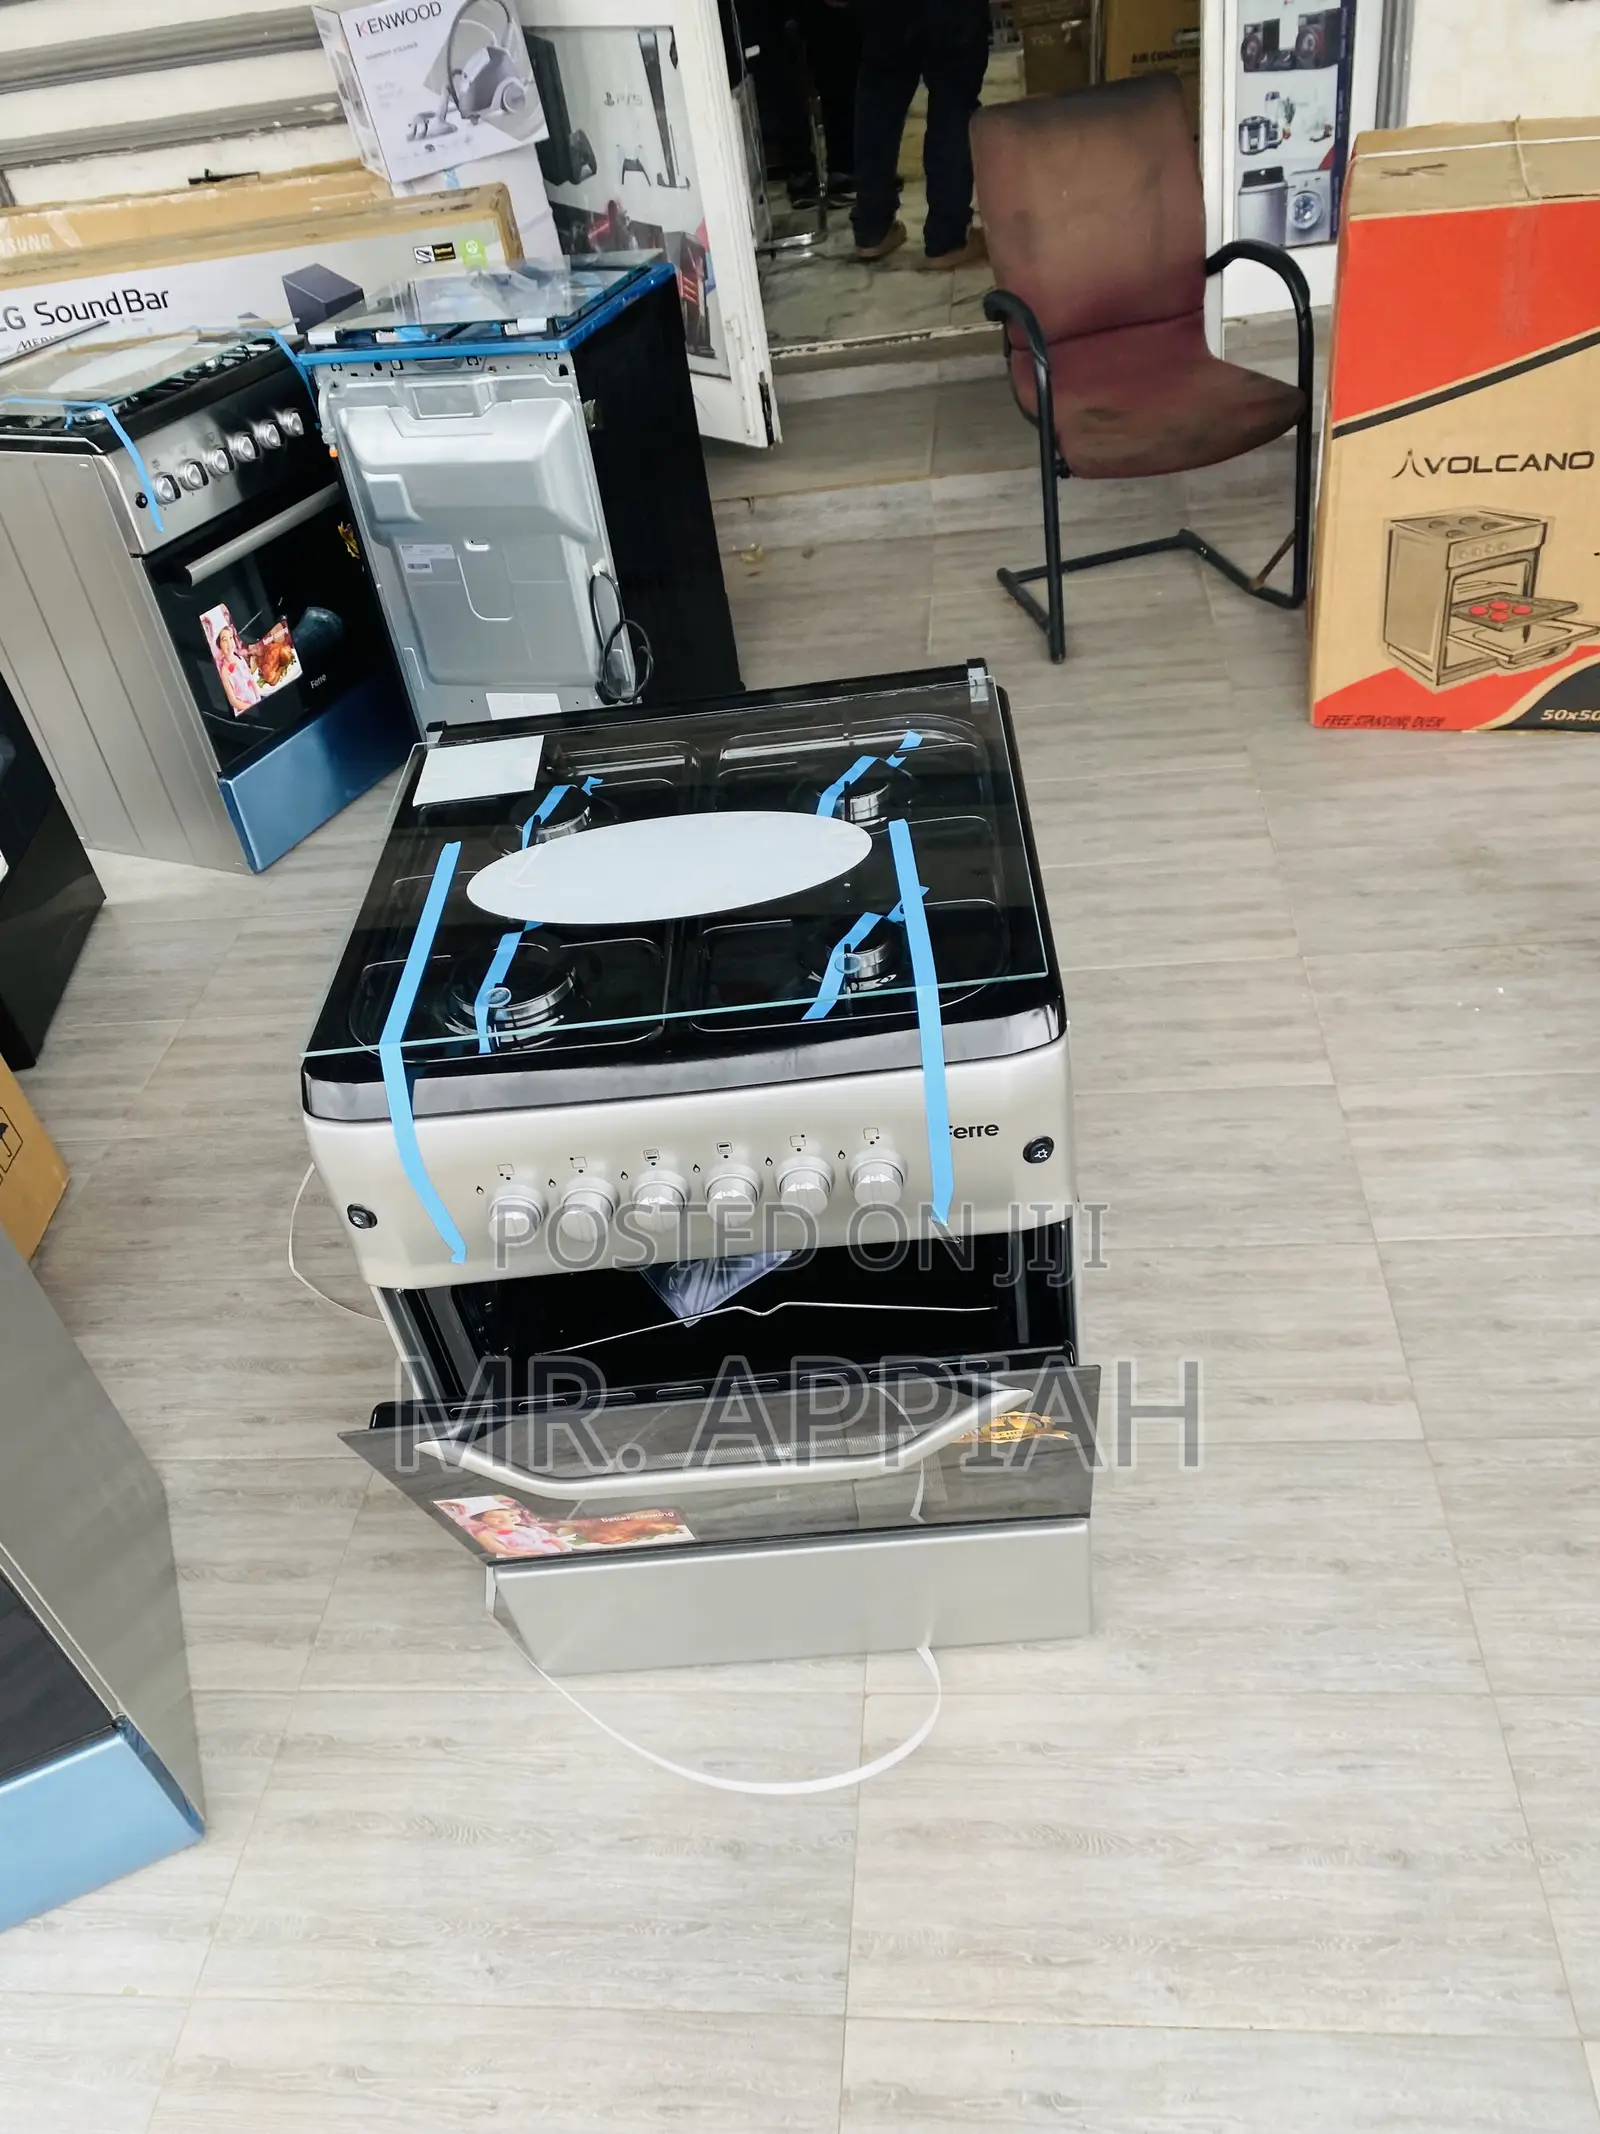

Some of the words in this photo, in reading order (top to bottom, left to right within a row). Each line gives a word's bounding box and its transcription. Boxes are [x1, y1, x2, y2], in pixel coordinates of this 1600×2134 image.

[355, 1, 442, 38] KENWOOD
[1424, 451, 1595, 475] VOLCANO
[310, 674, 327, 689] Ferre
